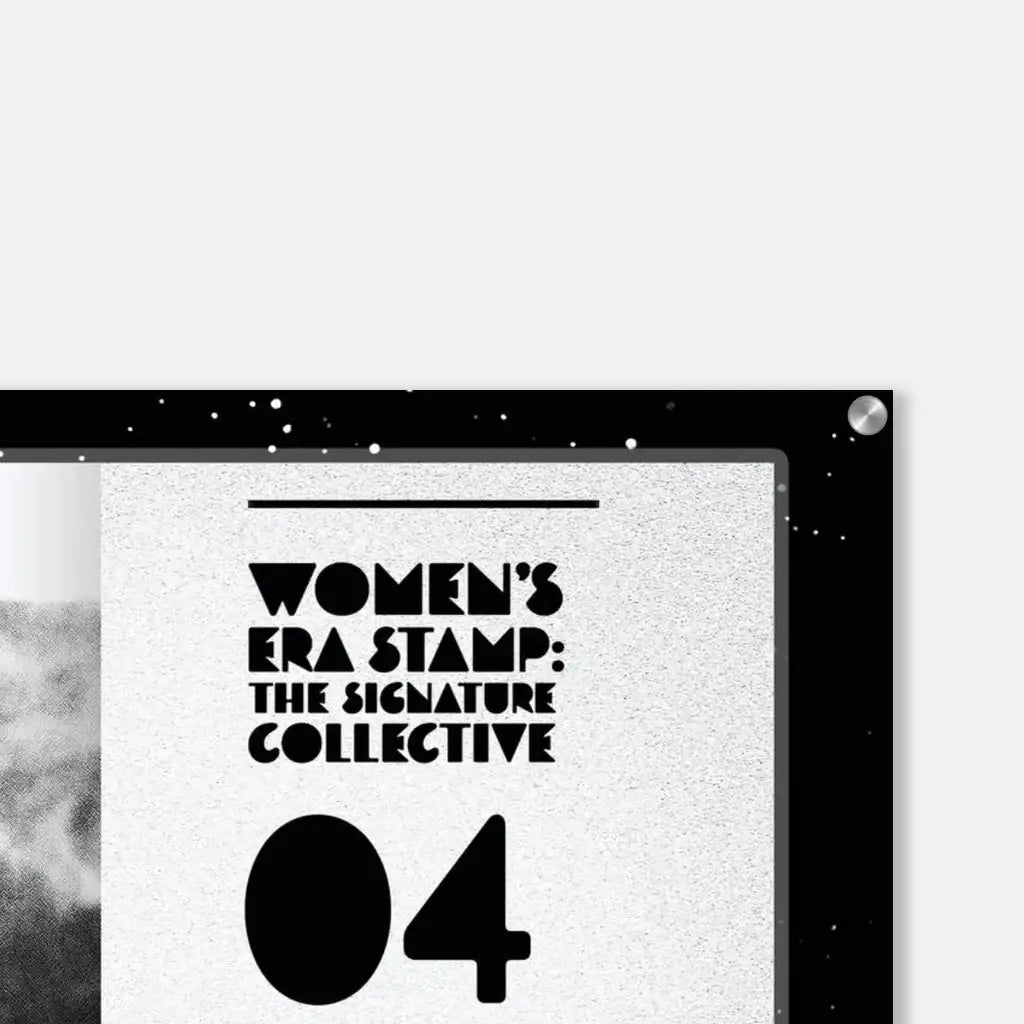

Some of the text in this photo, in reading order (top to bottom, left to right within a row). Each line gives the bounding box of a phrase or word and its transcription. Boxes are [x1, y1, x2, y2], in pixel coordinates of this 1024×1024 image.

[248, 561, 564, 617] WOMEN'S
[248, 626, 565, 673] ERA STAMP:
[248, 681, 557, 715] THE SIGNATURE
[248, 722, 556, 764] COLLECTIVE
[244, 814, 532, 1006] 04
